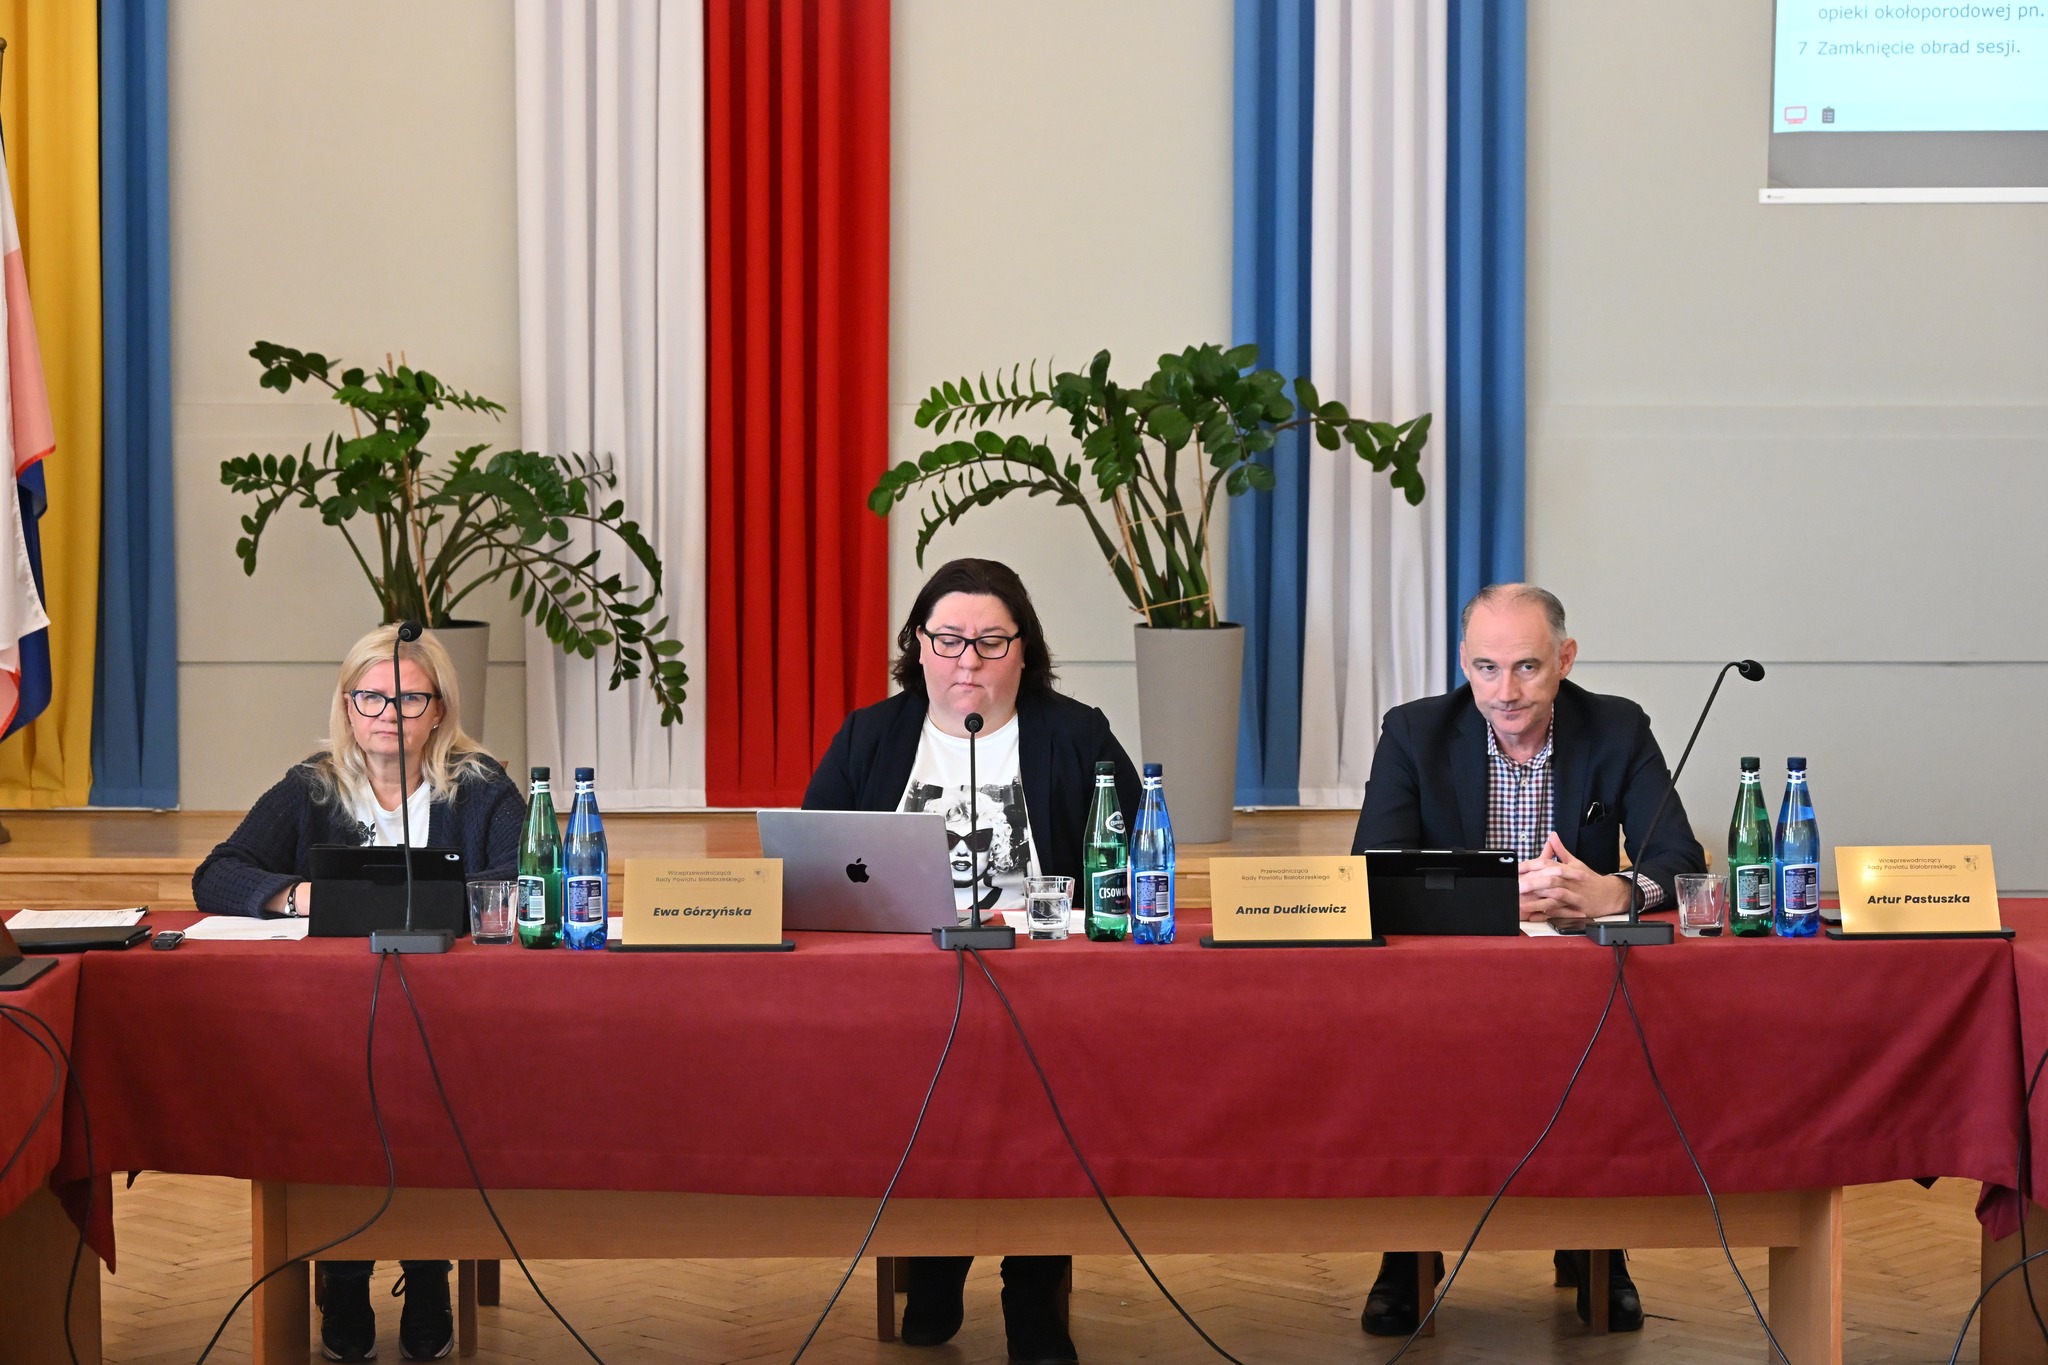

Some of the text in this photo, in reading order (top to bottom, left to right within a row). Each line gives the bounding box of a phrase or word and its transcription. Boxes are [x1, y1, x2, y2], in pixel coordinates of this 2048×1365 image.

[1818, 3, 2045, 22] opieki okołoporodowej pn.
[1798, 39, 2021, 58] 7 Zamknięcie obrad sesji.
[1867, 894, 1970, 905] Artur Pastuszka
[653, 906, 752, 919] Ewa Górzyńska
[1235, 903, 1347, 915] Anna Dudkiewicz
